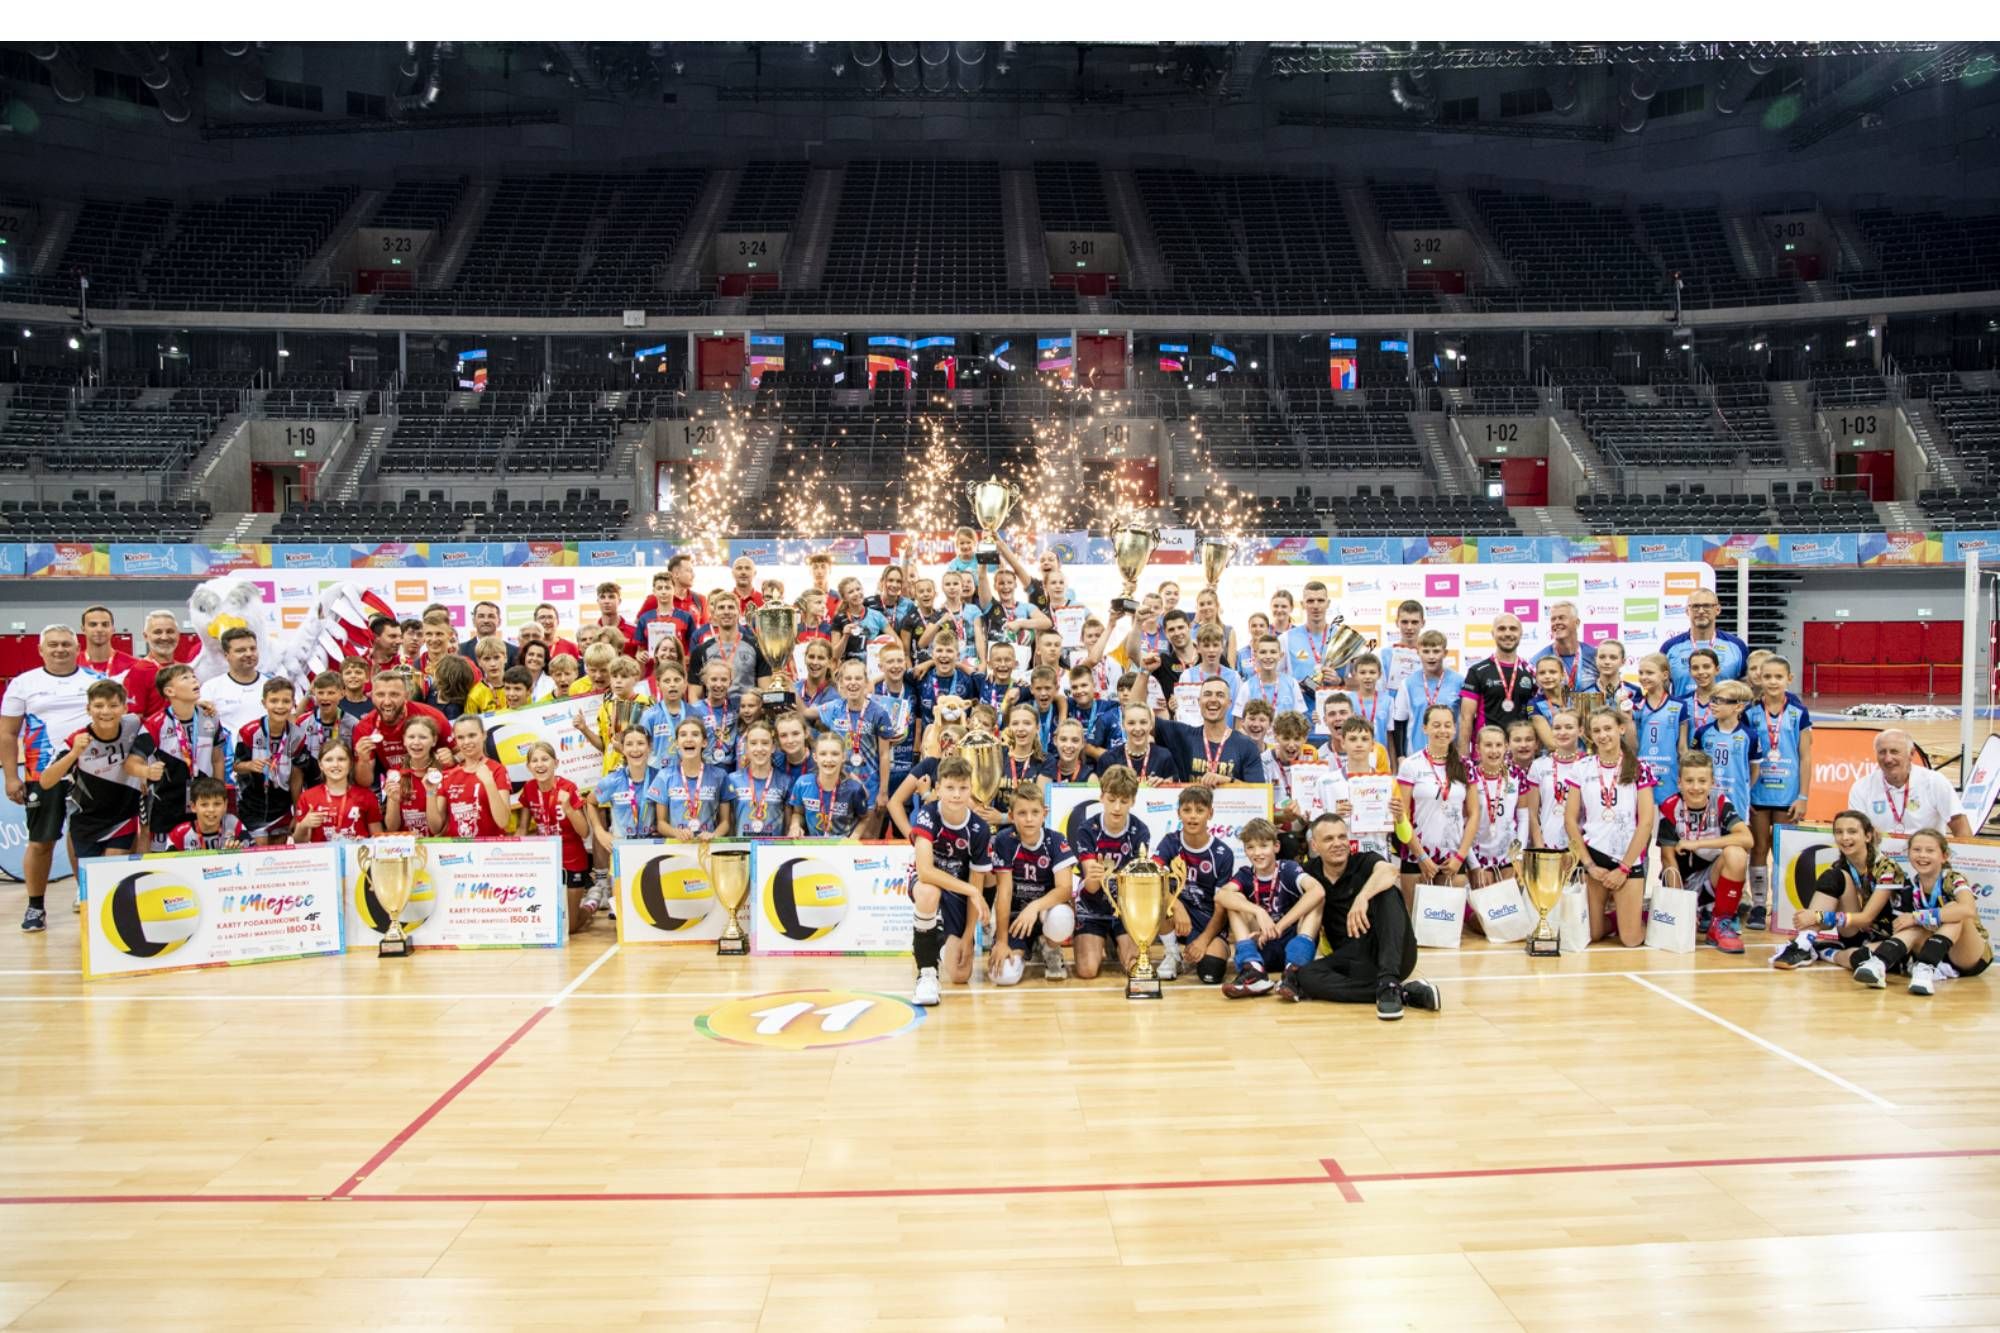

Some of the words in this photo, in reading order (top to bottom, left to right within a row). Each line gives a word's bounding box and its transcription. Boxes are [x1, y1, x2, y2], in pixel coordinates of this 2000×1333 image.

[1775, 222, 1805, 239] 3-03
[383, 237, 412, 252] 3-23
[739, 240, 767, 255] 3-24
[1069, 240, 1094, 255] 3-01
[1413, 238, 1441, 252] 3-02
[1486, 424, 1518, 442] 1-02
[1841, 415, 1876, 436] 1-03
[285, 427, 315, 446] 1-19
[684, 426, 715, 445] 1-20
[859, 634, 867, 650] 7
[1650, 727, 1658, 743] 9
[105, 742, 125, 765] 21
[1714, 748, 1729, 766] 99
[348, 805, 360, 822] 4
[556, 804, 565, 820] 3
[1024, 862, 1036, 882] 13
[470, 882, 536, 905] Miejsce
[240, 893, 315, 916] Miejsce
[449, 906, 470, 914] KARTY
[472, 906, 522, 914] PODARUNKOWE
[1488, 903, 1519, 920] Gerflor
[510, 915, 529, 924] 1500
[1423, 907, 1455, 921] Gerflor
[216, 922, 242, 930] KARTY
[243, 916, 301, 927] PODARUNKOWE
[286, 924, 308, 935] 1800
[750, 1000, 876, 1035] 11
